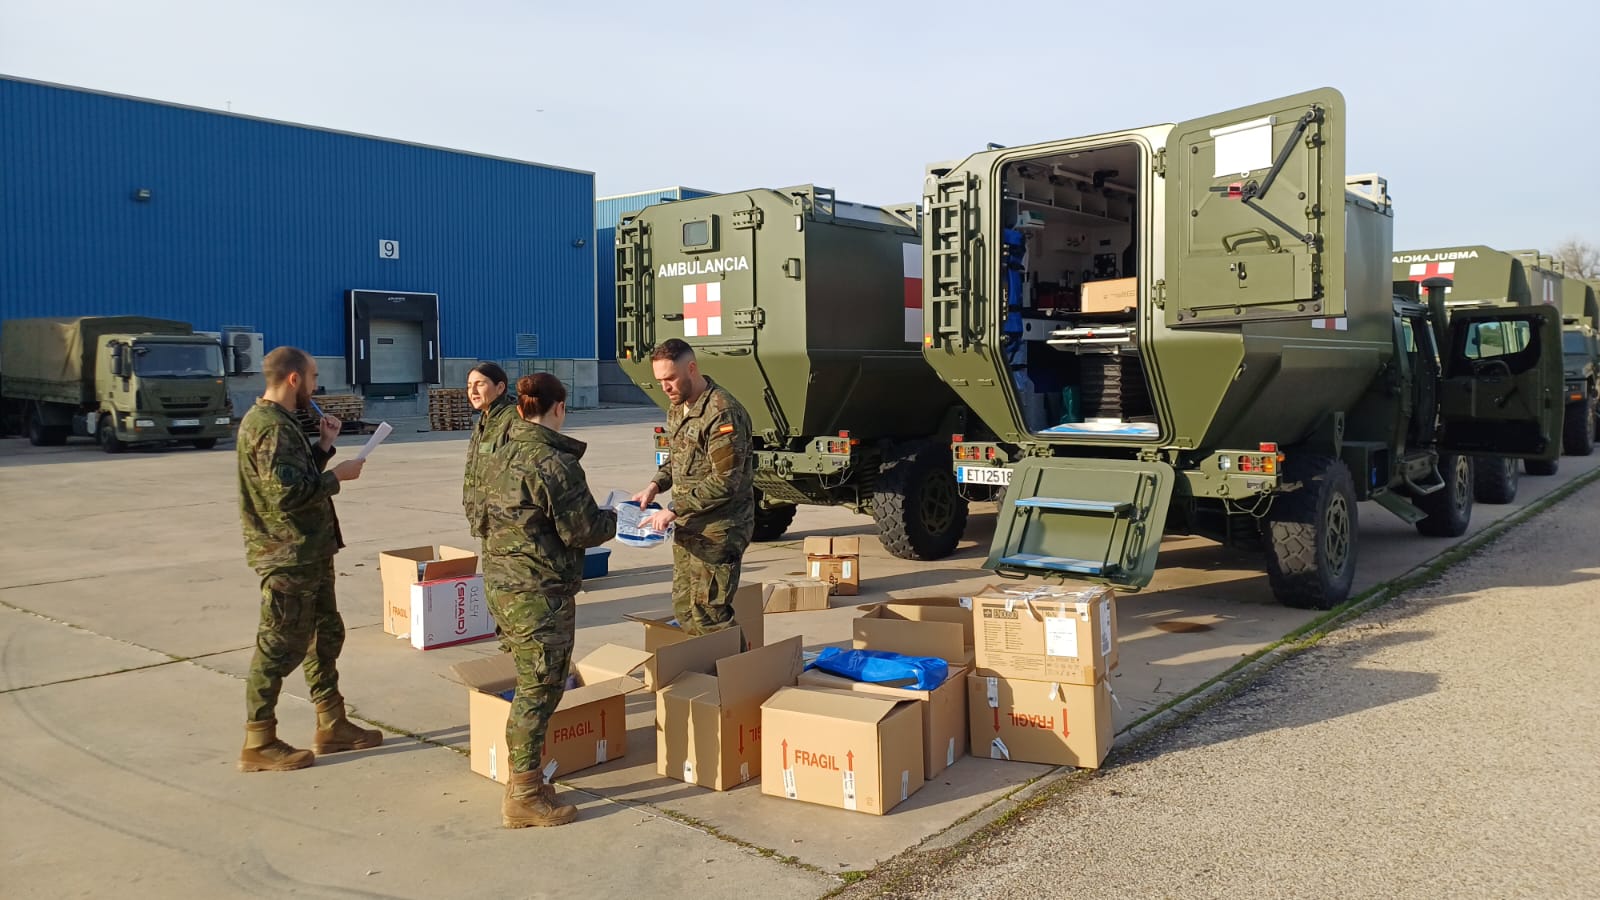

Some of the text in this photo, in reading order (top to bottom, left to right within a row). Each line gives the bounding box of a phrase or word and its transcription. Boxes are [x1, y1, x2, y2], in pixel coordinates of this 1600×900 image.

[384, 241, 394, 257] 9
[658, 256, 748, 277] AMBULANCIA
[393, 606, 408, 618] FRAGIL
[1008, 712, 1054, 729] FRAGIL
[554, 719, 594, 744] FRAGIL
[795, 750, 839, 770] FRAGIL
